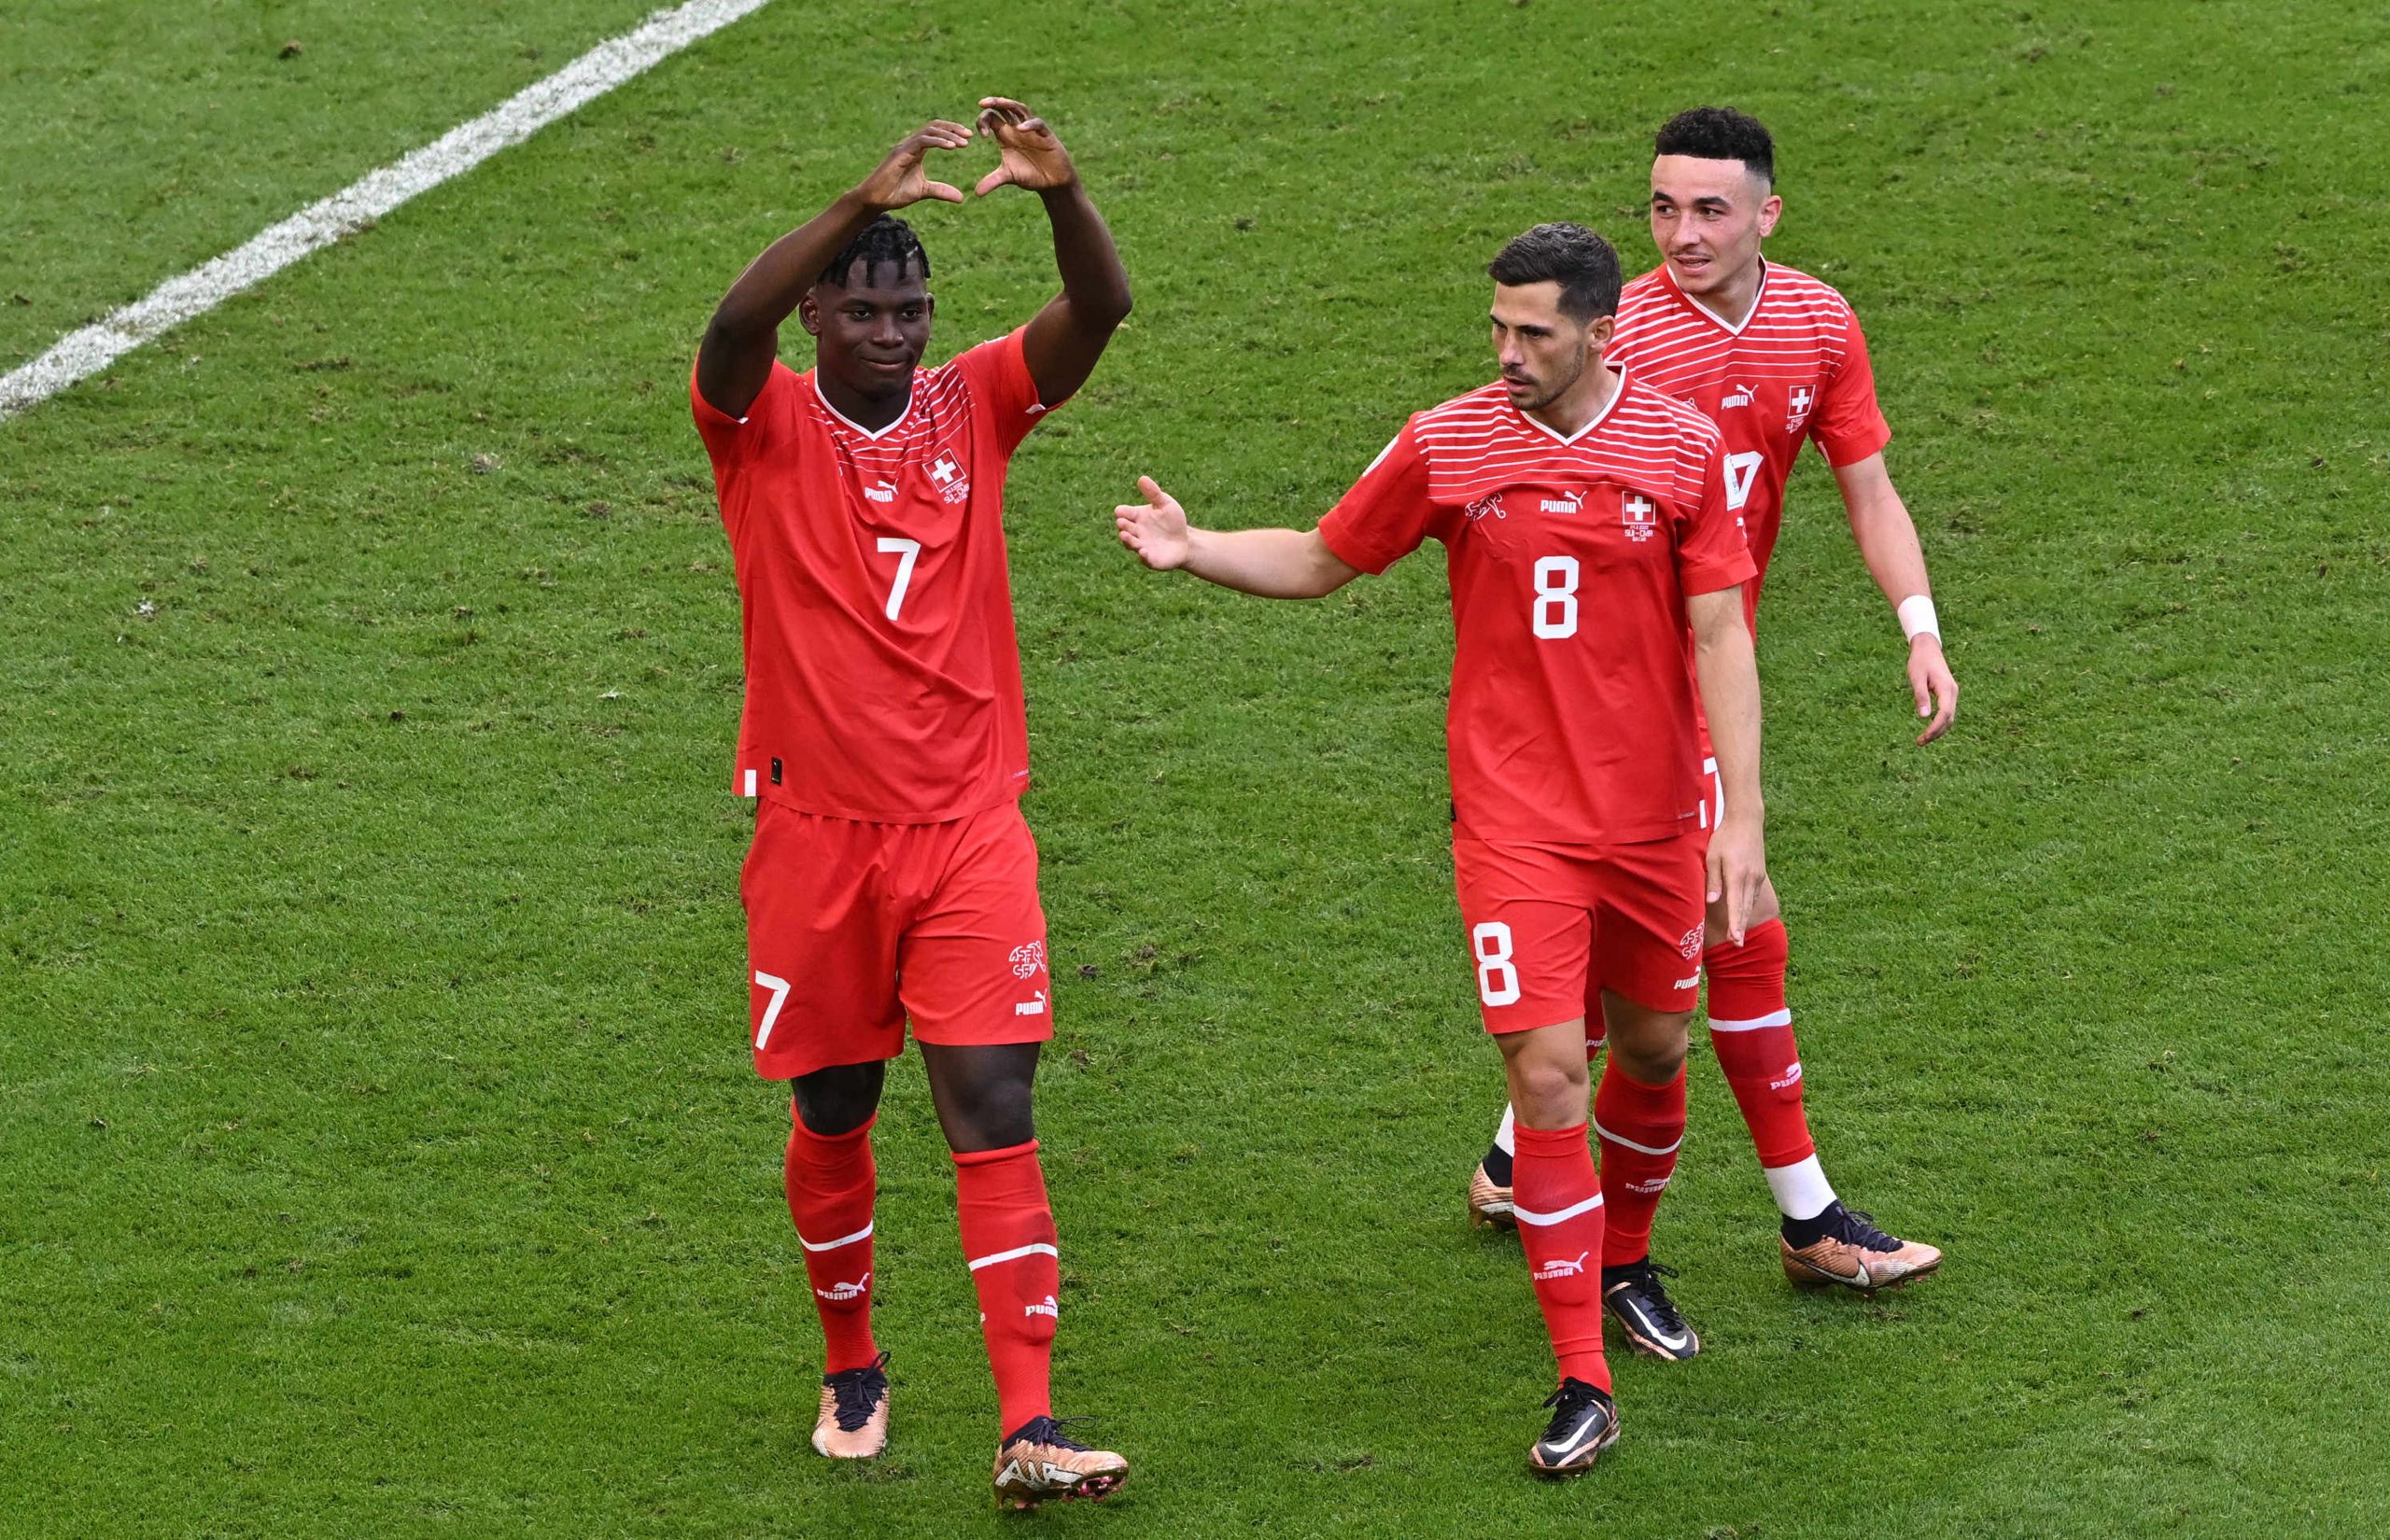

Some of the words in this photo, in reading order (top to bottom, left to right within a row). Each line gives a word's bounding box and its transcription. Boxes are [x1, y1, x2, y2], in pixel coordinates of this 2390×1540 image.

[1722, 394, 1749, 411] PUMA
[865, 486, 894, 503] PUMA
[1539, 499, 1577, 514] PUMA
[877, 537, 921, 622] 7
[1532, 555, 1580, 640] 8
[1472, 920, 1522, 1007] 8
[754, 970, 792, 1051] 7
[1015, 1001, 1044, 1015] PUMA
[1533, 1267, 1574, 1281] PUMA
[817, 1288, 858, 1300] PUMA
